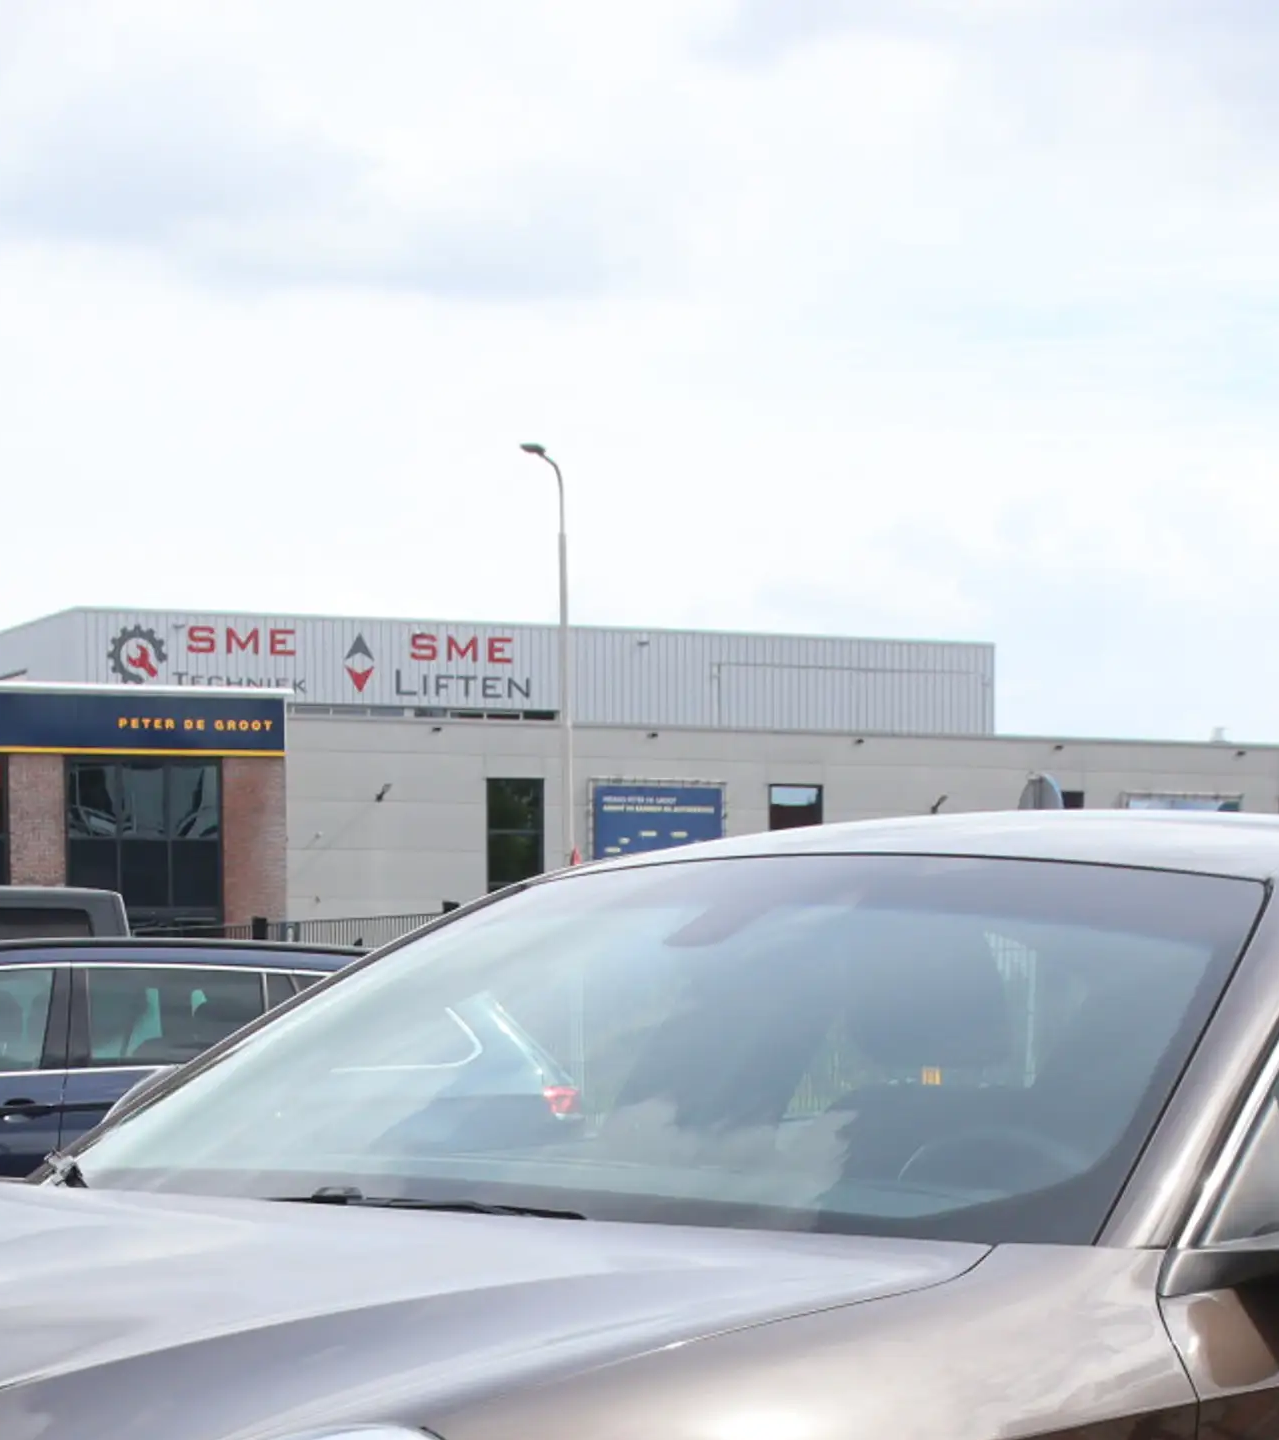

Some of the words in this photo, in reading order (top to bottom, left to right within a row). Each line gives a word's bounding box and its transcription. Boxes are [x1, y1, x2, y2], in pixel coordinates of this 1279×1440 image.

[186, 625, 296, 656] SME
[409, 632, 513, 664] SME
[394, 668, 531, 699] LIFTEN
[117, 716, 176, 730] PETER
[183, 718, 206, 731] DE
[213, 719, 273, 732] GROOT
